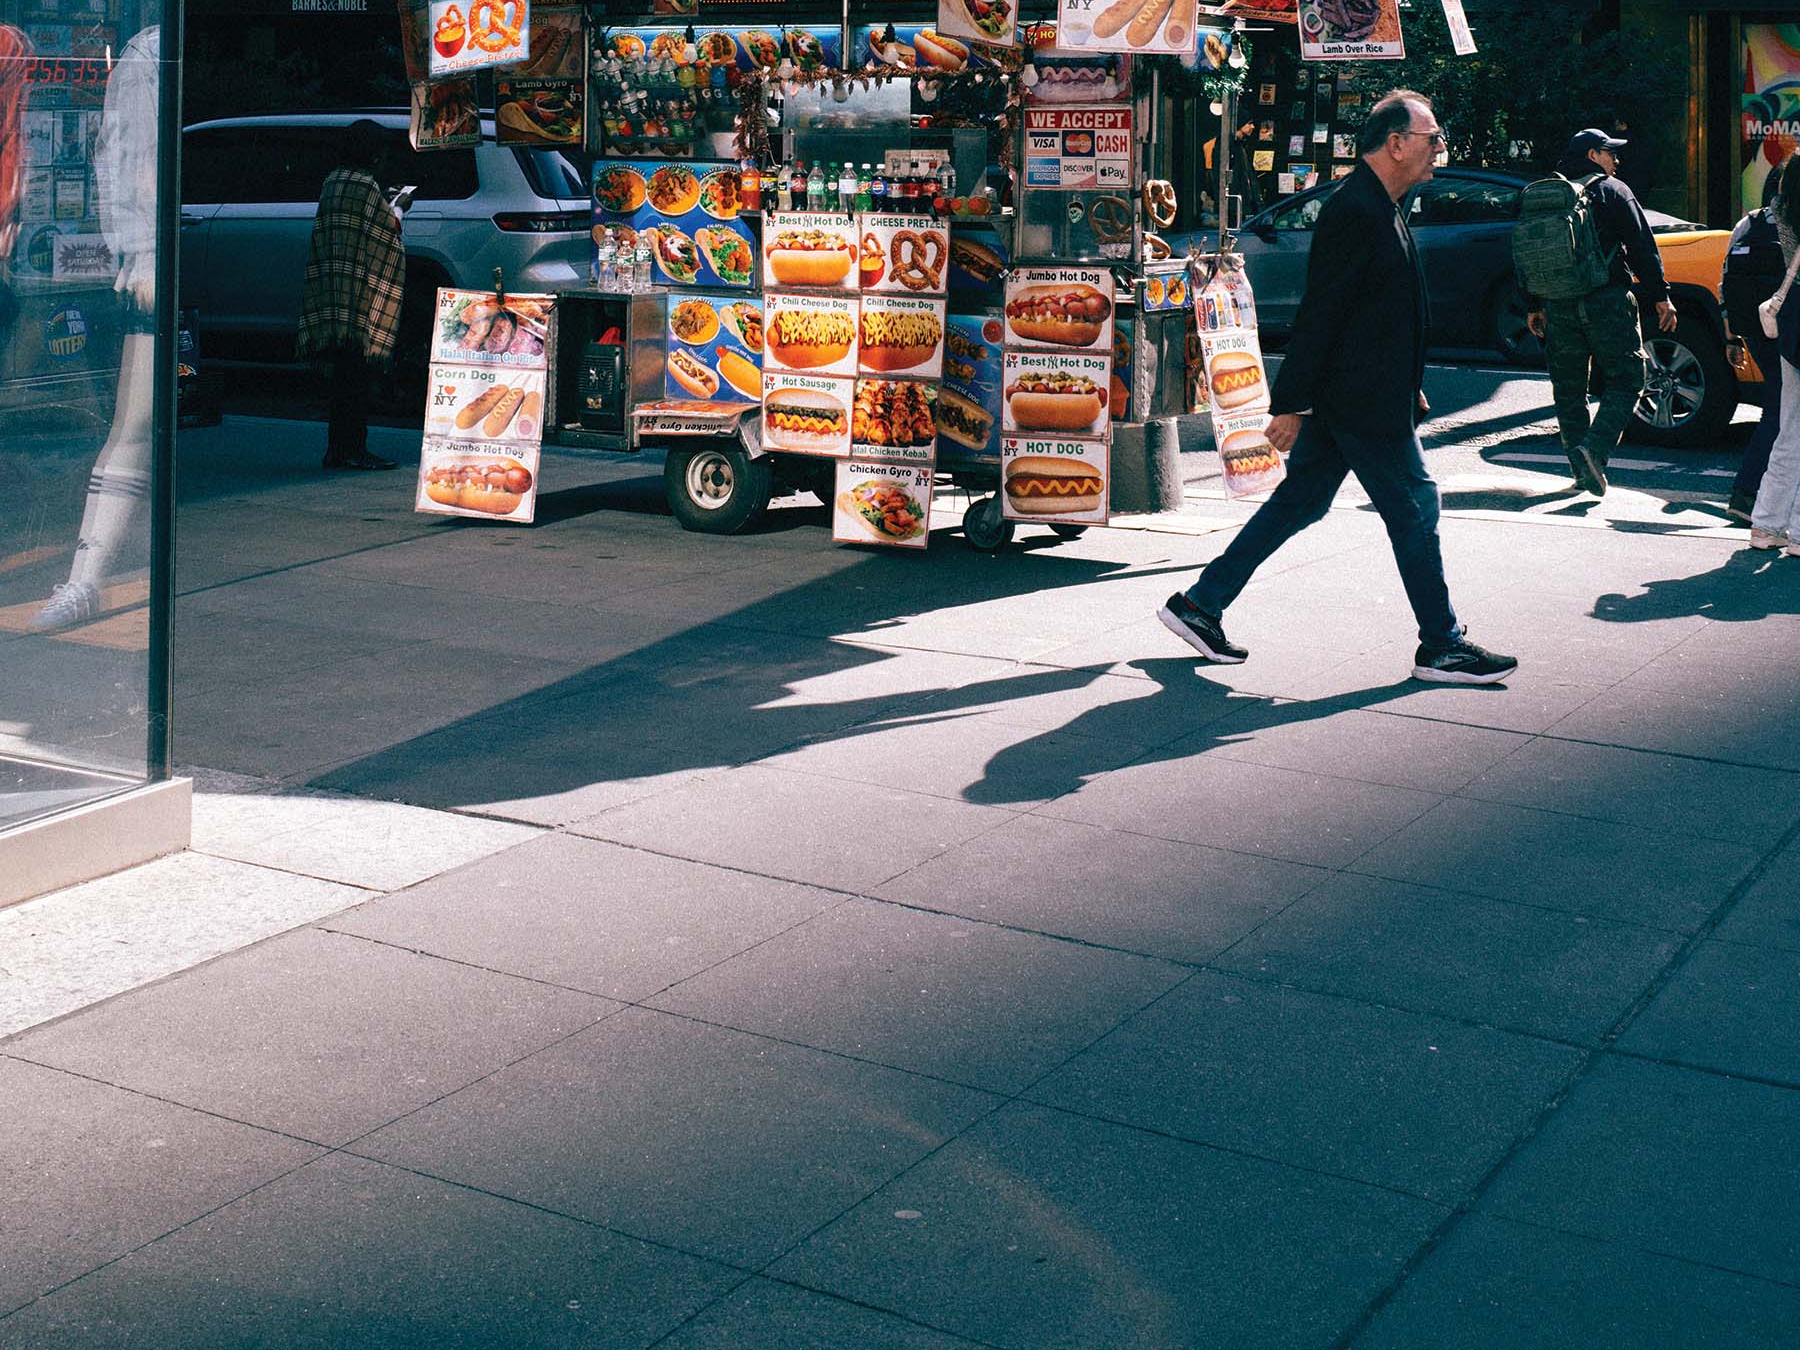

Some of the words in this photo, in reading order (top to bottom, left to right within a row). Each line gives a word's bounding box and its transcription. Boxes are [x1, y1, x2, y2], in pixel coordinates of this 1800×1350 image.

[1322, 44, 1343, 54] Lamb
[1345, 44, 1364, 54] Over
[1365, 43, 1384, 54] Rice
[1029, 112, 1057, 128] WE
[1060, 112, 1126, 129] ACCEPT
[1745, 119, 1800, 136] MoMA
[1033, 137, 1056, 149] VISA
[1095, 135, 1128, 153] CASH
[1028, 164, 1060, 172] AMERICAN
[1063, 164, 1095, 172] DISCOVER
[1107, 166, 1126, 180] Pay
[778, 215, 803, 227] Best
[813, 215, 834, 227] Hot
[834, 216, 855, 229] Dog
[869, 216, 905, 228] CHEESE
[906, 217, 946, 229] PRETZEL
[1025, 270, 1057, 283] Jumbo
[1059, 271, 1078, 282] Hot
[1078, 271, 1101, 285] Dog
[439, 300, 457, 309] NY
[766, 301, 777, 310] NY
[781, 297, 800, 308] Chili
[800, 298, 830, 310] Cheese
[831, 299, 848, 312] Dog
[866, 297, 885, 308] Chili
[885, 298, 916, 310] Cheese
[917, 299, 935, 312] Dog
[48, 335, 86, 356] LOTTERY
[1216, 339, 1231, 351] HOT
[1231, 336, 1247, 349] DOG
[1005, 360, 1019, 369] NY
[1021, 355, 1046, 367] Best
[1059, 357, 1078, 368] Hot
[1080, 358, 1106, 371] Dog
[434, 368, 468, 380] Corn
[470, 369, 497, 383] Dog
[436, 384, 445, 395] I
[781, 376, 797, 388] Hot
[798, 378, 838, 391] Sausage
[433, 394, 458, 406] NY
[446, 442, 481, 453] Jumbo
[482, 444, 502, 456] Hot
[503, 446, 525, 459] Dog
[868, 446, 901, 458] Chicken
[902, 448, 929, 459] Kebab
[1003, 446, 1019, 457] NY
[1025, 441, 1053, 455] HOT
[1056, 441, 1085, 456] DOG
[849, 464, 887, 476] Chicken
[888, 466, 912, 479] Gyro
[914, 476, 929, 487] NY
